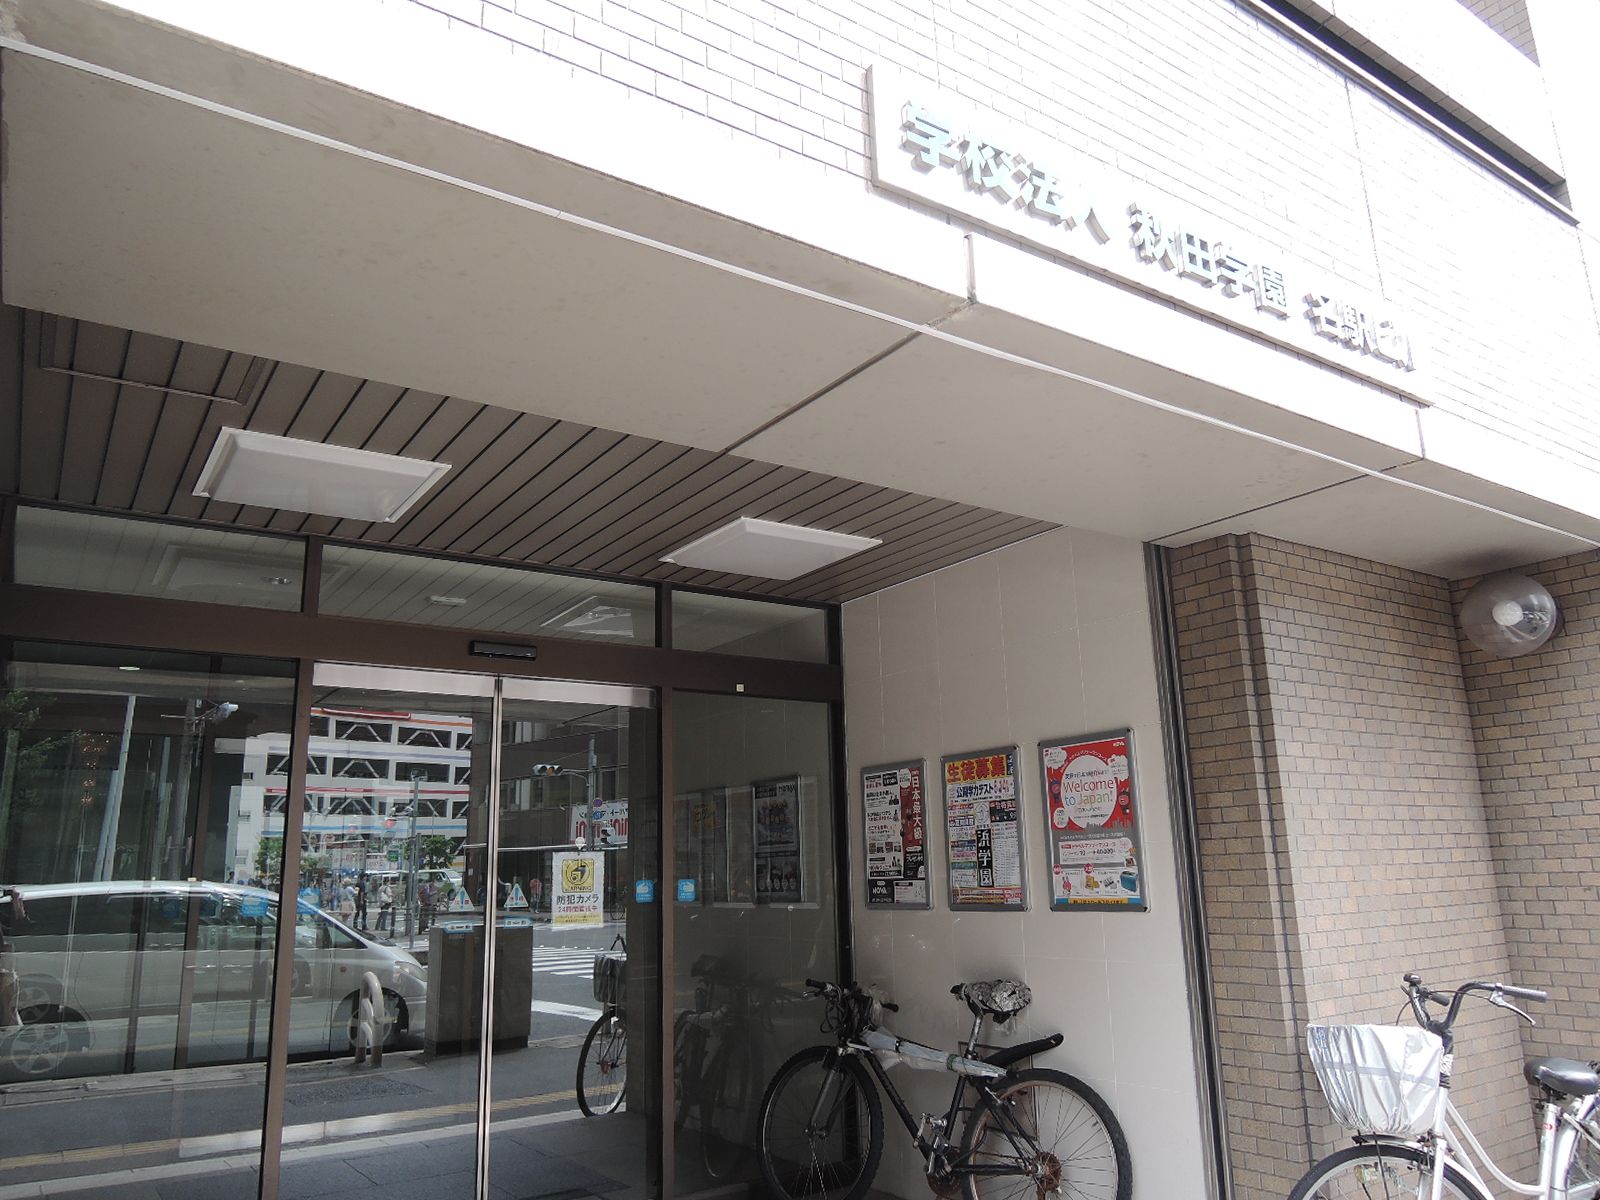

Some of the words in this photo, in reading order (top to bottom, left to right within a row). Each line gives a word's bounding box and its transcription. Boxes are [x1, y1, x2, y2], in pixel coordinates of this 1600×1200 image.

[898, 98, 1111, 245] 学校法人
[1125, 200, 1290, 320] 秋田学園
[947, 755, 1006, 783] 生徒募集
[1063, 779, 1115, 793] Welcome
[1064, 795, 1076, 806] to
[1080, 791, 1113, 807] Japan!
[978, 829, 993, 886] 浜学園
[556, 894, 600, 905] 防犯カメラ
